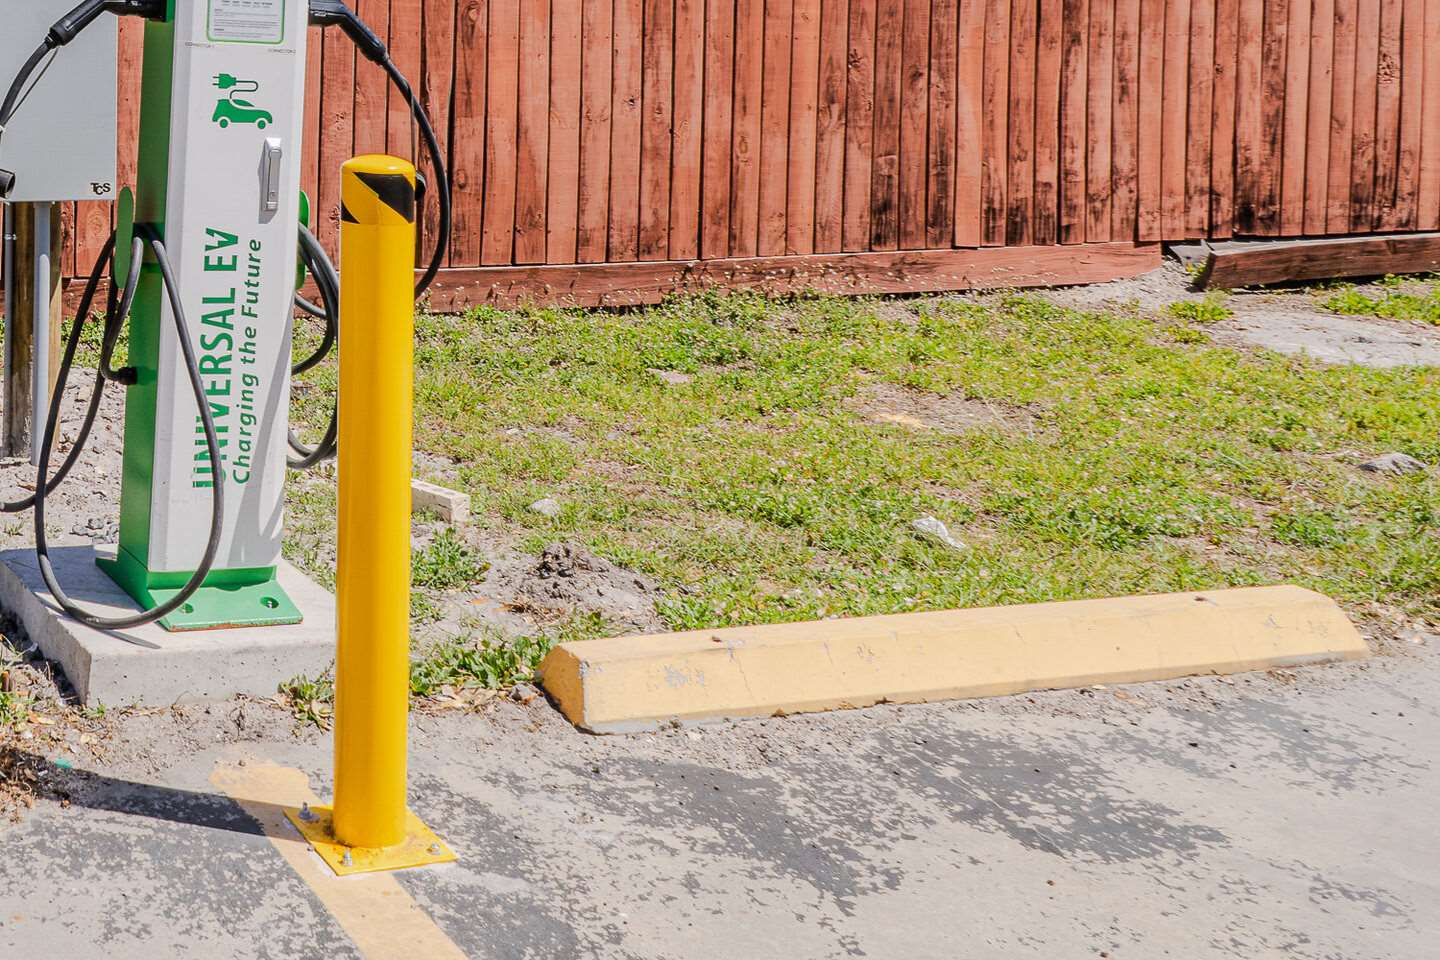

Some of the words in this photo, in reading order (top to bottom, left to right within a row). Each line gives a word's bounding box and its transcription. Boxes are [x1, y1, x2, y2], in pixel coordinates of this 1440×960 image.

[90, 182, 111, 196] TCS
[203, 227, 239, 272] EV
[240, 239, 262, 319] Future
[238, 326, 257, 365] the
[192, 287, 236, 488] UNIVERSAL
[232, 372, 260, 485] Charging
